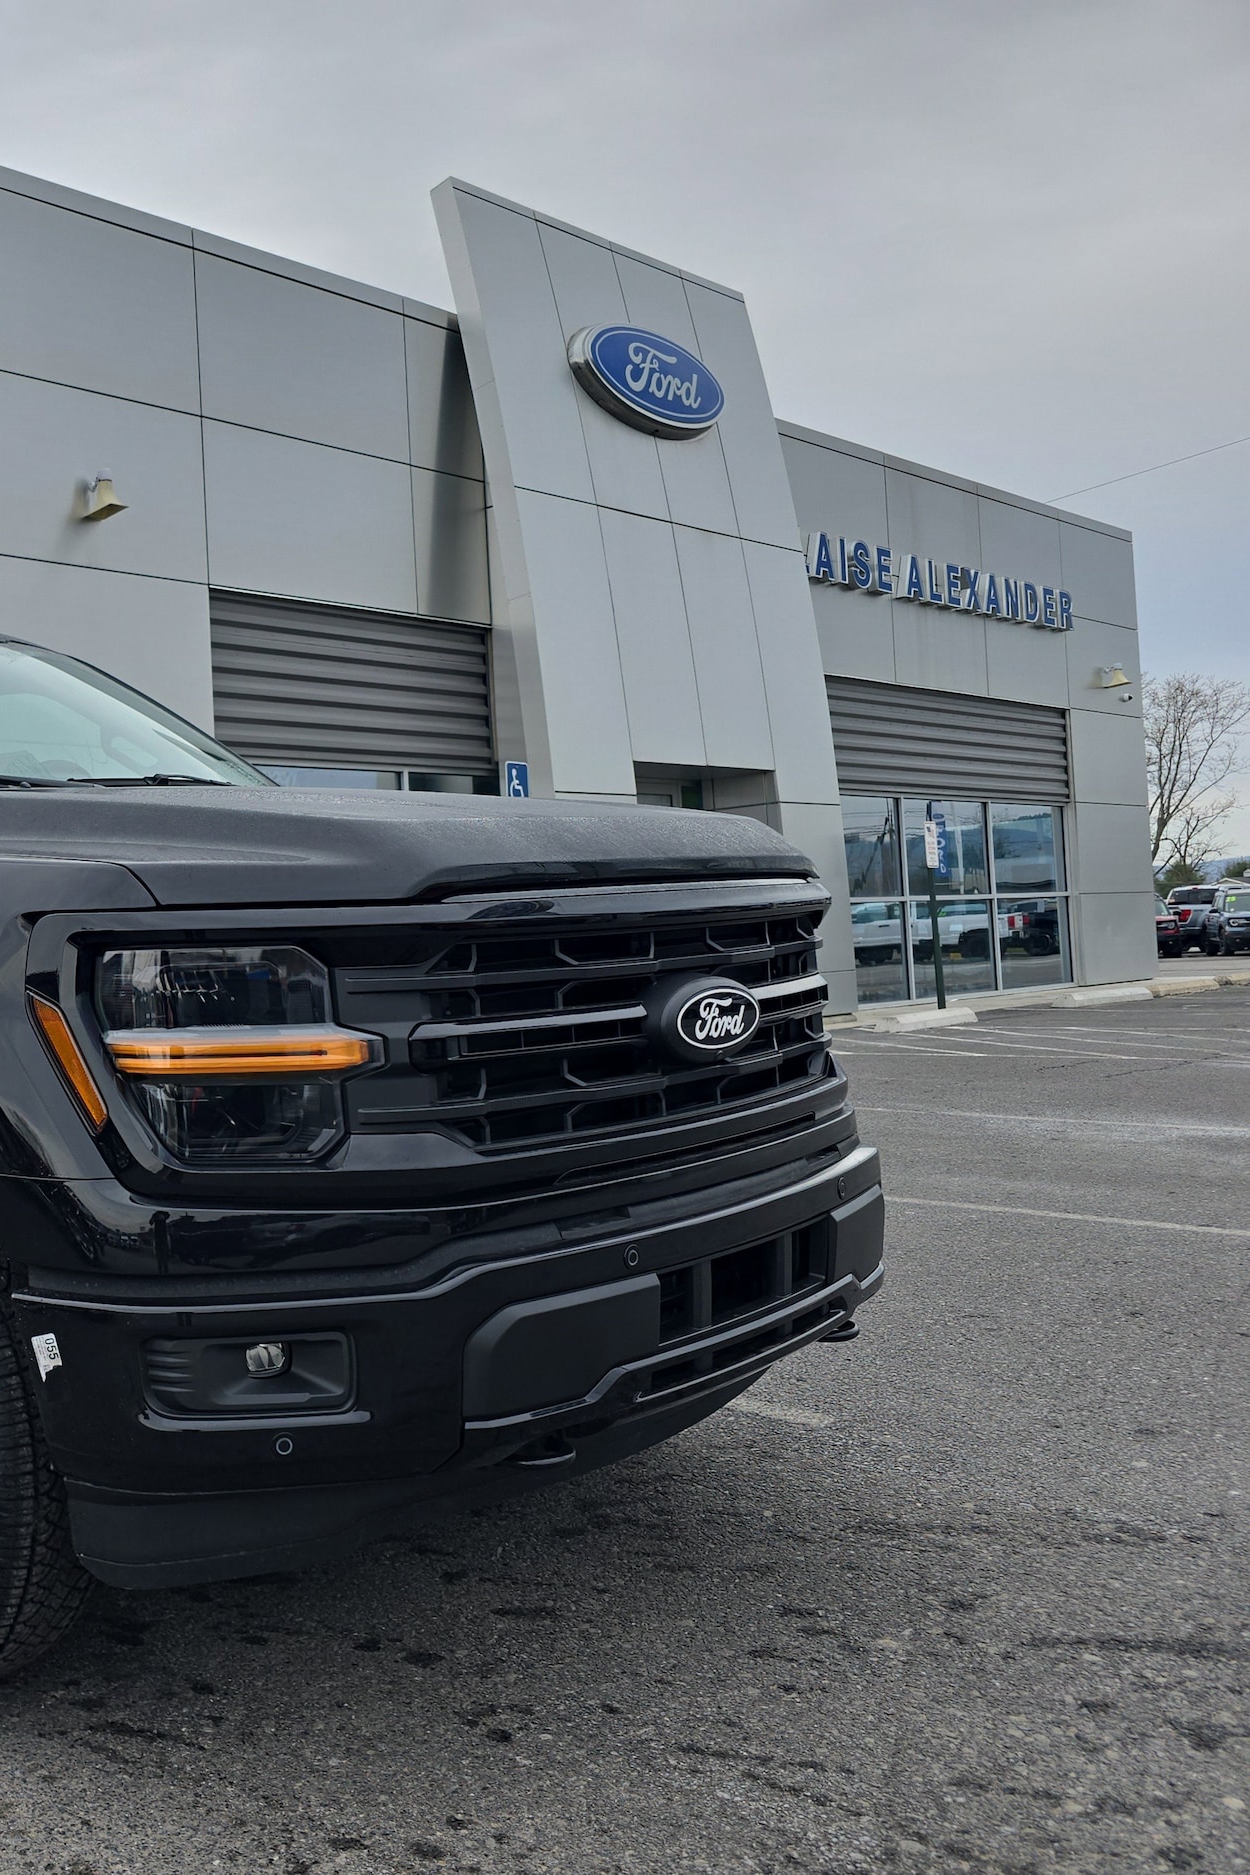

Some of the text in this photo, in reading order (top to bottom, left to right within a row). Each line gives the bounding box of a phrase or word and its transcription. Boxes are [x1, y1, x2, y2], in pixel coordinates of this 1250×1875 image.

[625, 342, 702, 409] Ford
[806, 531, 1074, 631] AISE ALEXANDER
[695, 998, 746, 1040] Ford
[44, 1337, 60, 1360] 055
